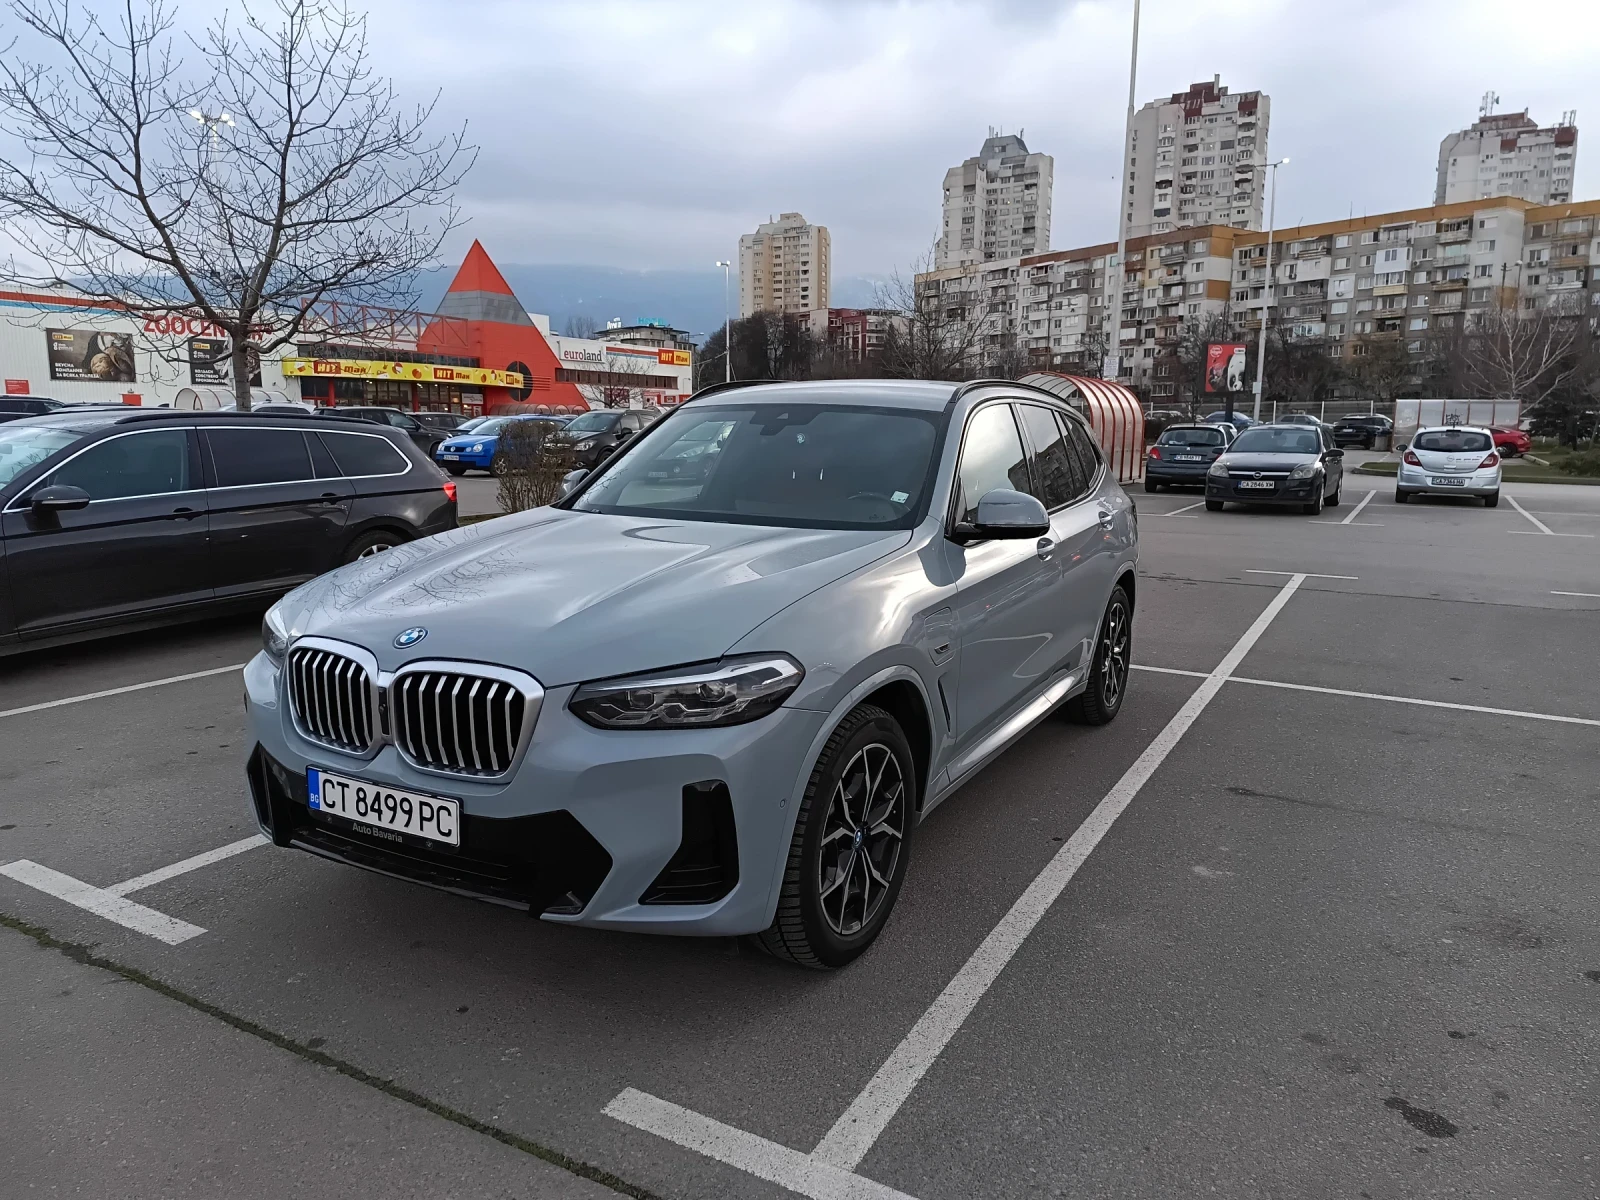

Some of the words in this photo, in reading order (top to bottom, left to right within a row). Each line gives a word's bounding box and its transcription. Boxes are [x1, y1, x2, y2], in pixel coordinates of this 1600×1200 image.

[564, 349, 602, 362] euroland
[661, 352, 672, 362] HIT
[436, 369, 452, 379] HIT
[455, 372, 470, 380] Max
[310, 792, 319, 804] BG
[322, 778, 350, 812] CT
[355, 786, 413, 828] 8499
[419, 800, 452, 837] PC
[352, 822, 372, 836] Auto
[372, 828, 403, 843] Bavaria
